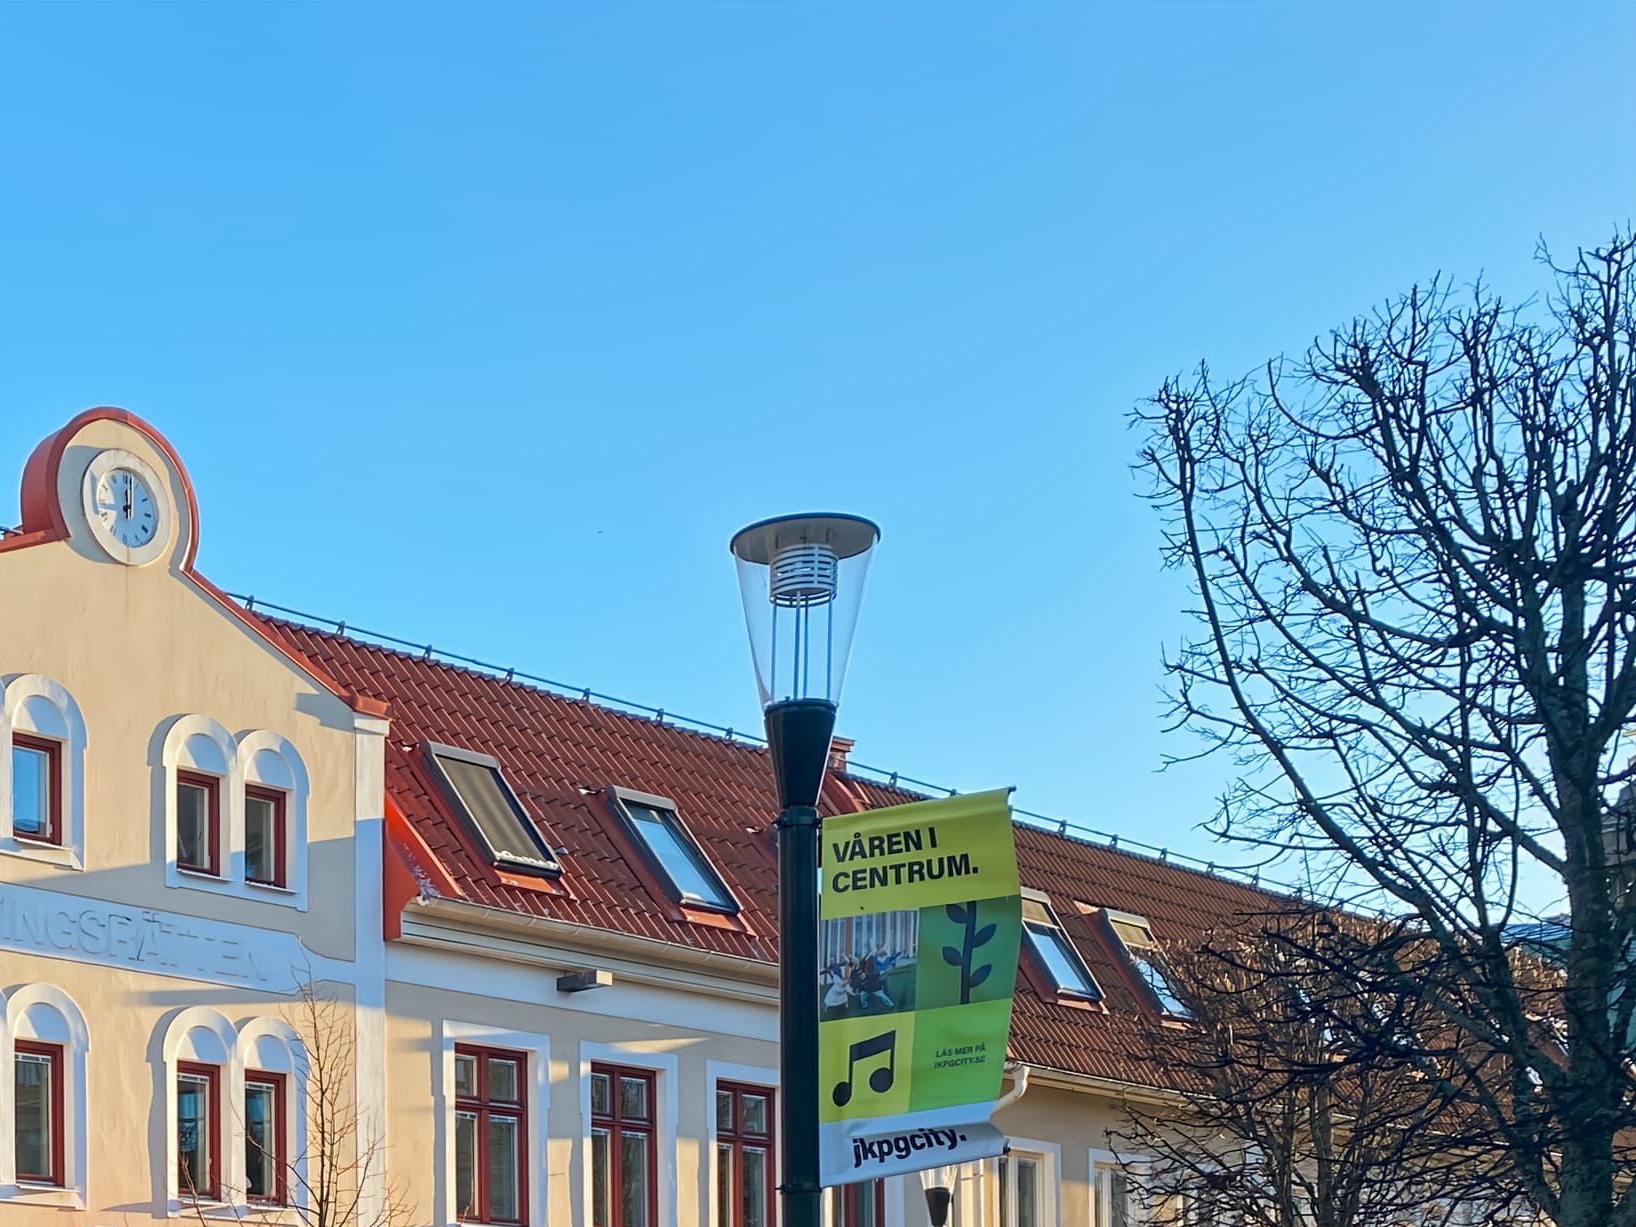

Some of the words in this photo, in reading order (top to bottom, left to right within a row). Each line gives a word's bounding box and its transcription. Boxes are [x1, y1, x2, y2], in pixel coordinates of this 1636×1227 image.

[832, 828, 923, 863] VÅREN
[927, 826, 937, 848] I
[831, 853, 979, 894] CENTRUM.
[936, 1048, 953, 1058] LÄS
[955, 1046, 973, 1055] MER
[851, 1127, 967, 1167] jkpgcity.
